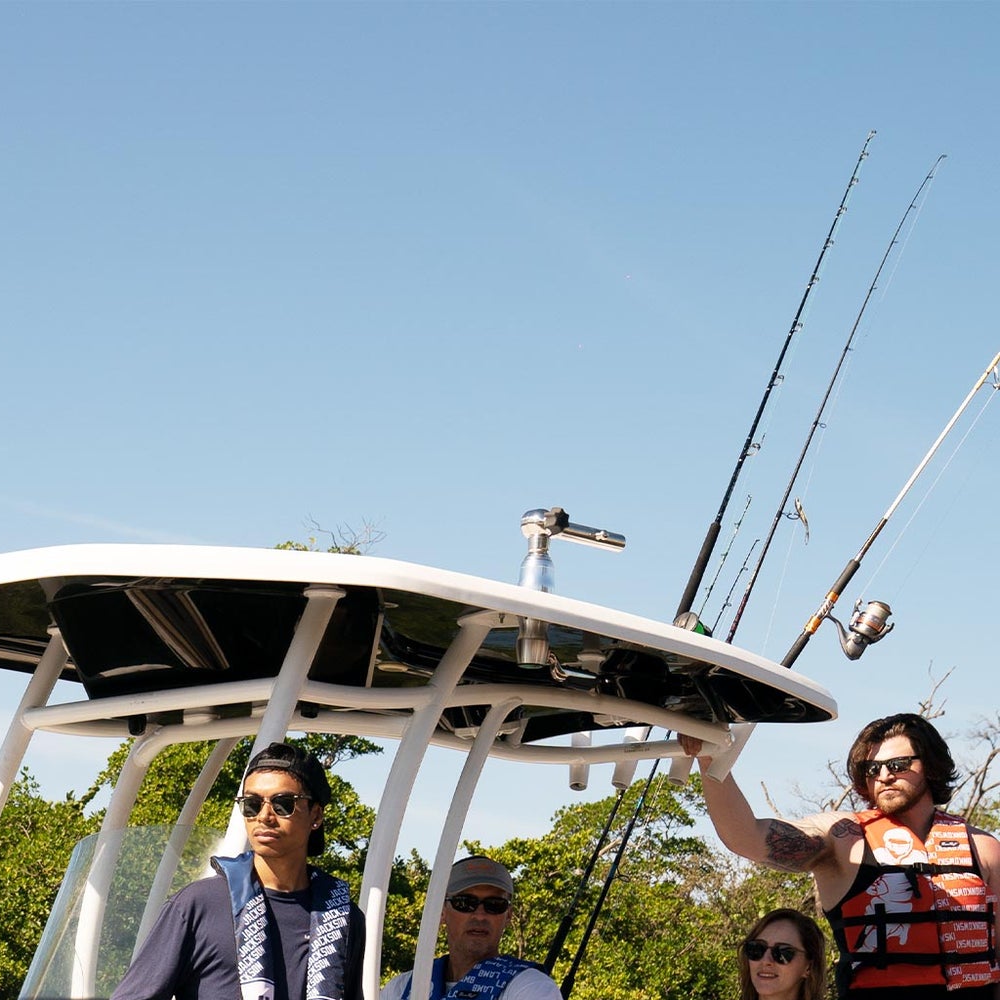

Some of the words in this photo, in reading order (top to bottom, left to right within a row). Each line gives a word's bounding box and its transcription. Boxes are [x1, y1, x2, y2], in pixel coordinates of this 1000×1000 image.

[315, 916, 348, 937] JACKSON
[310, 929, 343, 953] JACKSON
[478, 969, 501, 979] LAMB
[472, 984, 494, 994] LAMB
